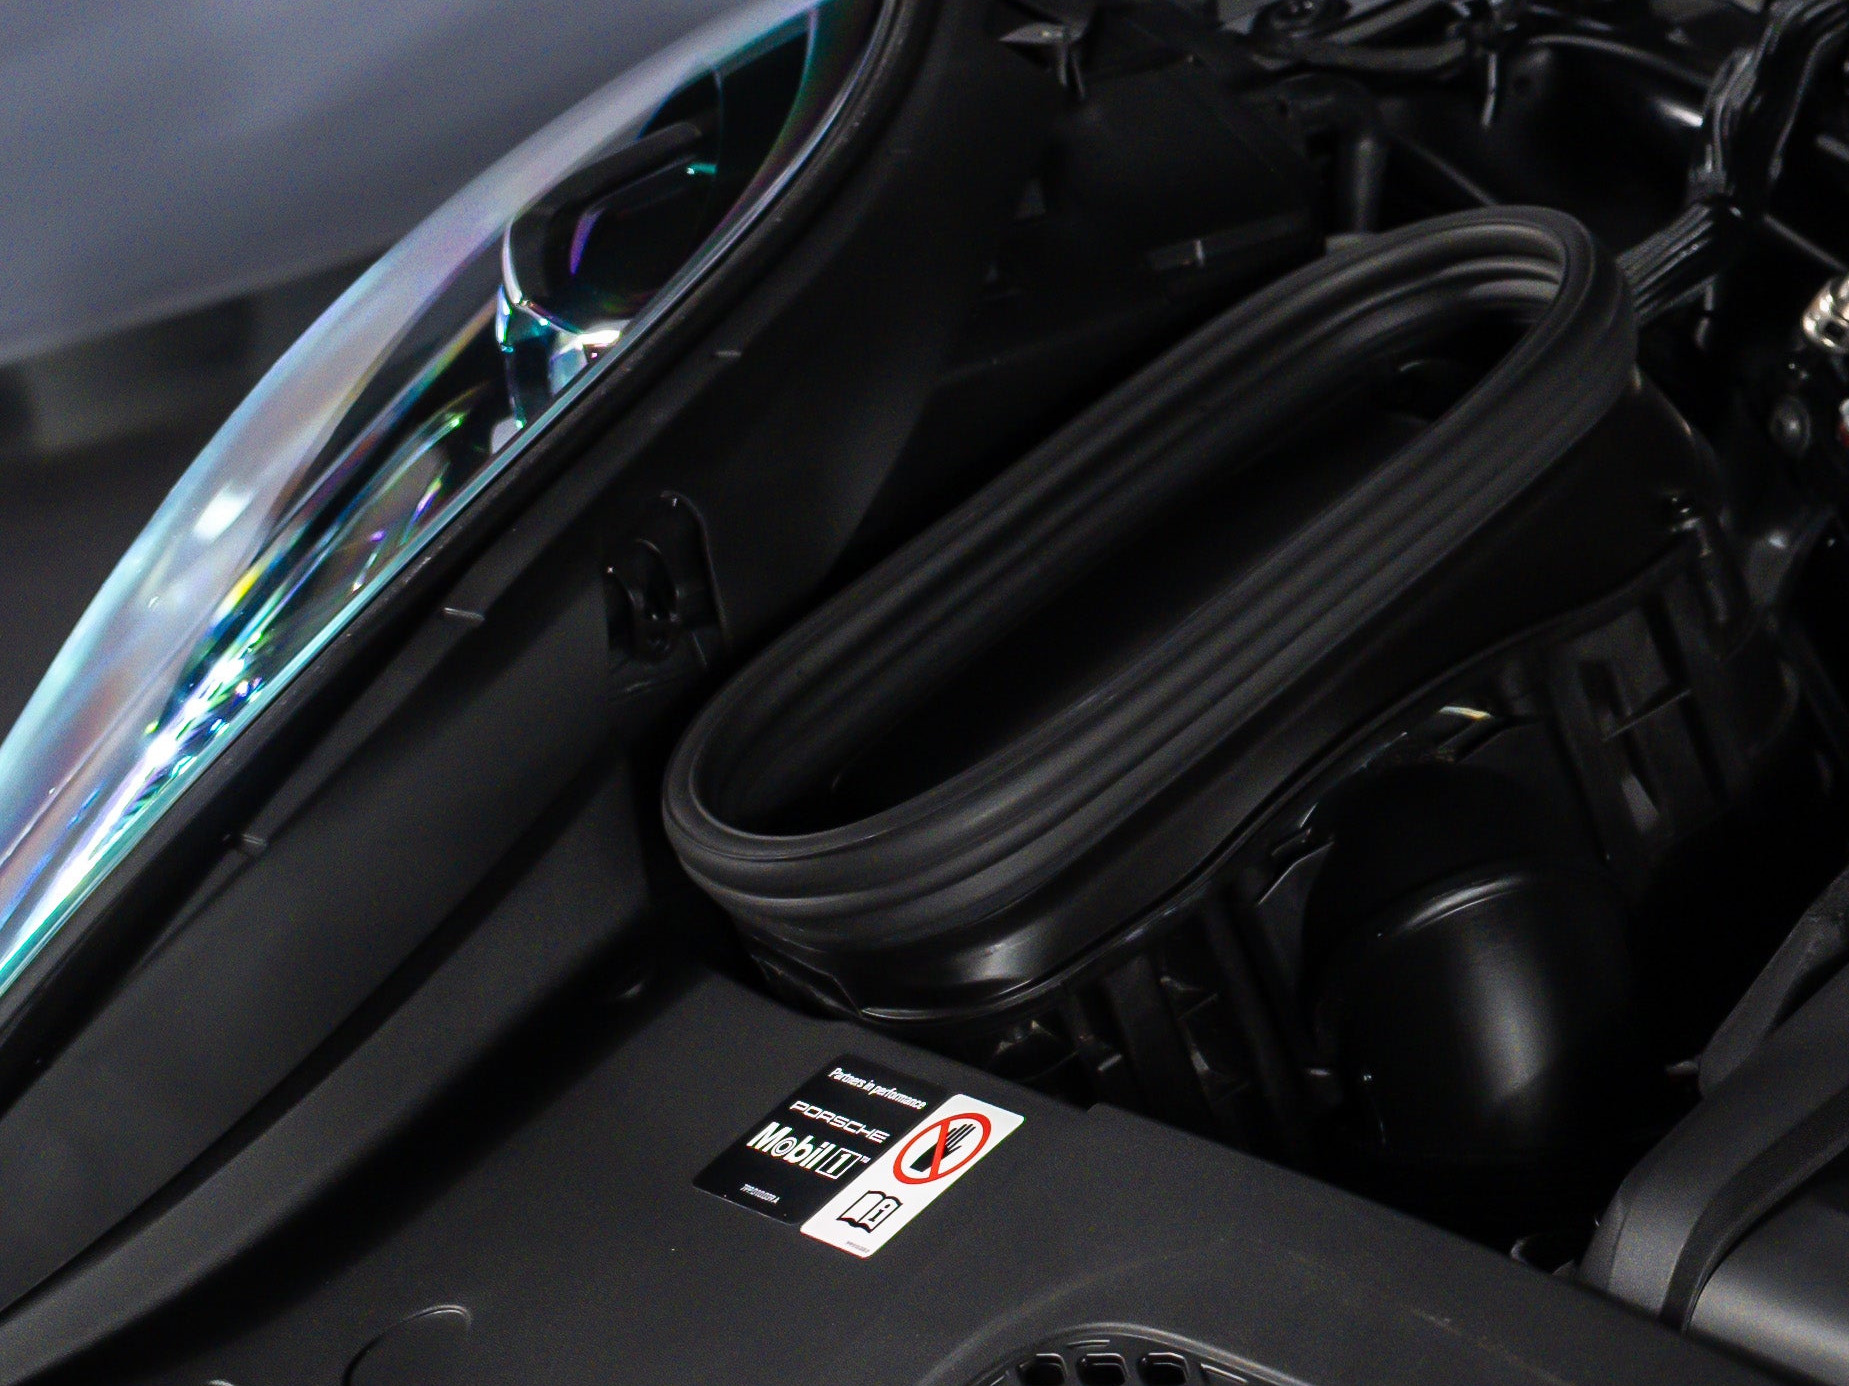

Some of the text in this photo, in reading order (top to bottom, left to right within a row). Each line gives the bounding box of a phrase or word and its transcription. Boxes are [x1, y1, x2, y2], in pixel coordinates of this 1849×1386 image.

[828, 1067, 927, 1110] Partners in performance
[788, 1100, 891, 1144] PORSCHE
[746, 1121, 836, 1169] Mobil
